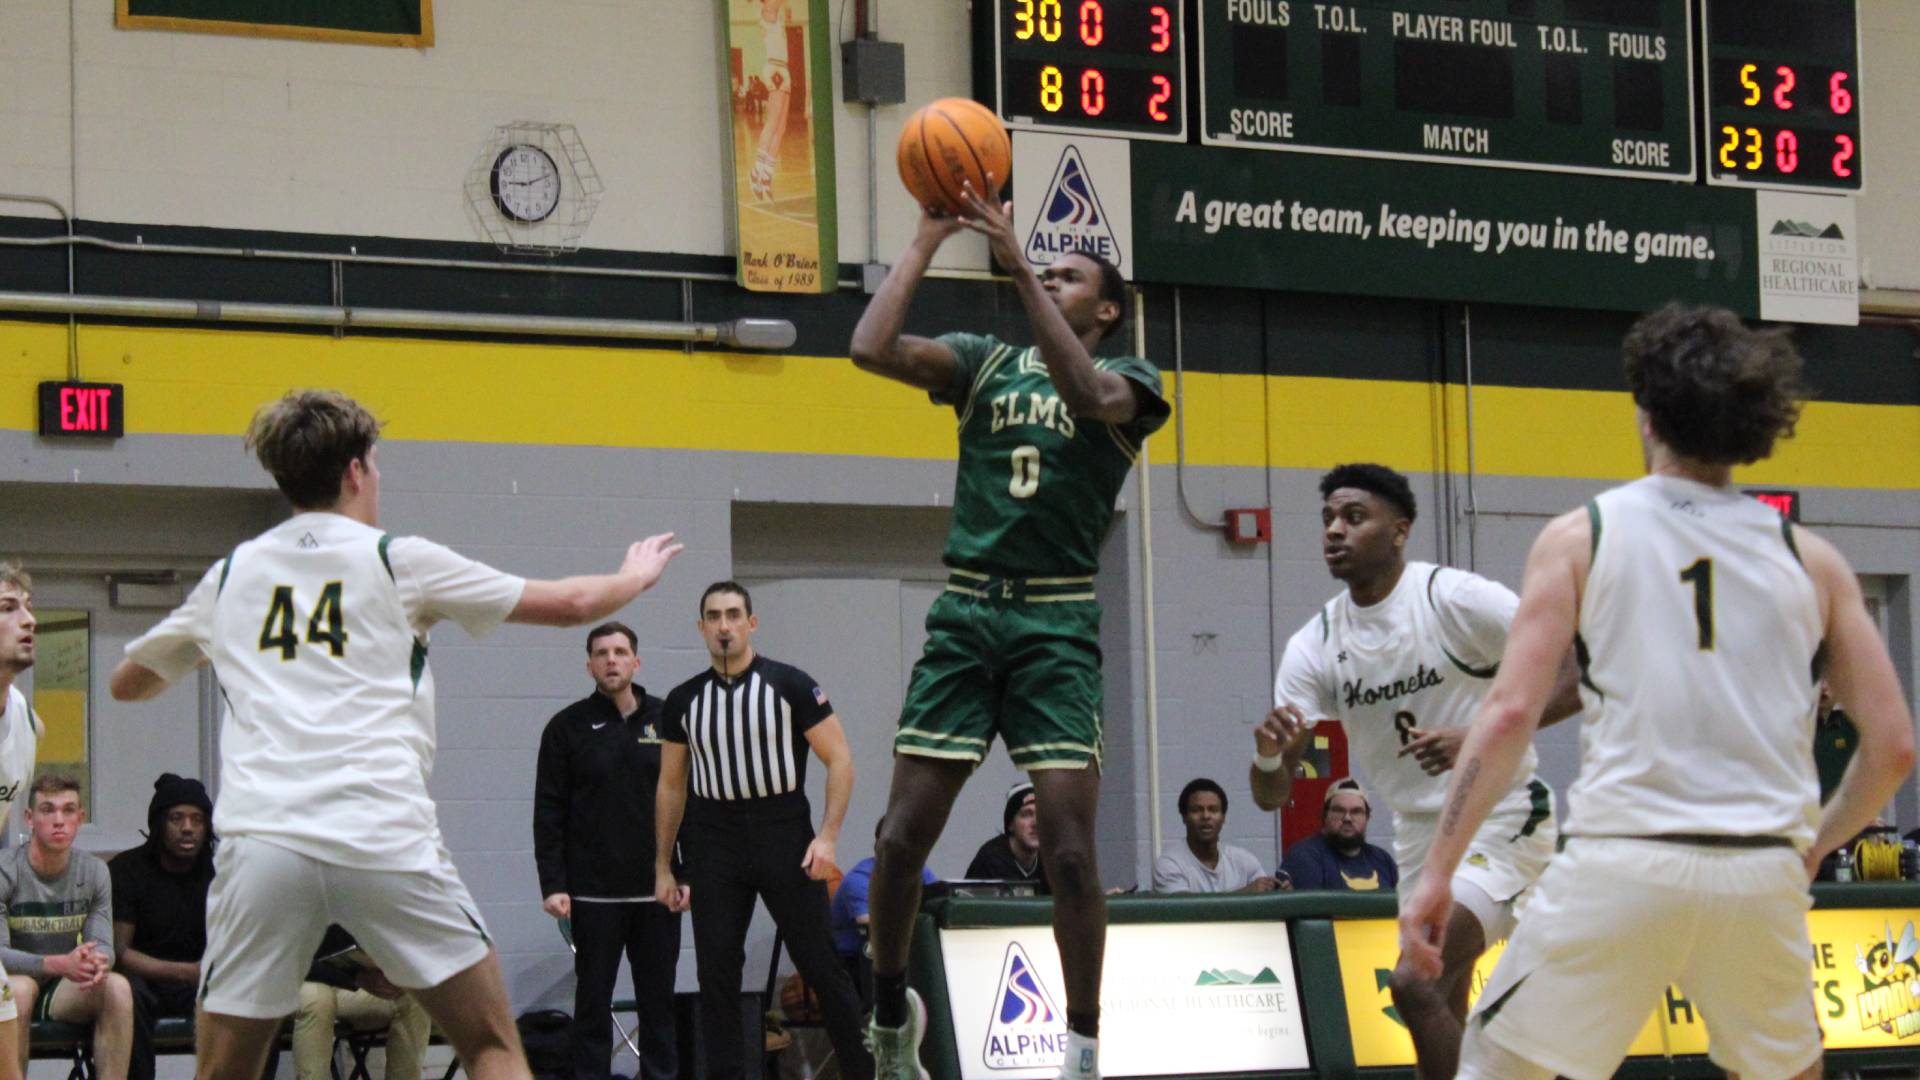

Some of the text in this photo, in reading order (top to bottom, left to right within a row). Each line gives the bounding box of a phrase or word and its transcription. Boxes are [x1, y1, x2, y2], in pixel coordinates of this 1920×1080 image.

[1015, 0, 1062, 42] 30
[1079, 0, 1103, 46] 0
[1150, 6, 1171, 53] 3
[1227, 0, 1290, 26] FOULS
[1314, 4, 1368, 33] T.O.L.
[1392, 11, 1518, 47] PLAYER FOUL
[1537, 25, 1589, 53] T.O.L.
[1608, 32, 1667, 61] FOULS
[1040, 66, 1063, 112] 8
[1081, 69, 1104, 116] 0
[1149, 75, 1171, 122] 2
[1740, 64, 1761, 106] 5
[1773, 66, 1796, 110] 2
[1829, 71, 1852, 115] 6
[1230, 108, 1294, 138] SCORE
[1423, 124, 1489, 154] MATCH
[1611, 139, 1670, 167] SCORE
[1720, 126, 1763, 170] 23
[1775, 129, 1798, 173] 0
[1831, 134, 1854, 177] 2
[1175, 191, 1715, 264] A great team, keeping you in the game.
[788, 272, 815, 287] 1989
[1763, 275, 1856, 294] HEALTHCARE
[1772, 258, 1846, 277] REGIONAL
[60, 387, 112, 431] EXIT
[991, 391, 1075, 439] ELMS
[1009, 445, 1041, 498] 0
[258, 579, 349, 662] 44
[1679, 556, 1715, 651] 1
[1343, 663, 1444, 709] Hornets
